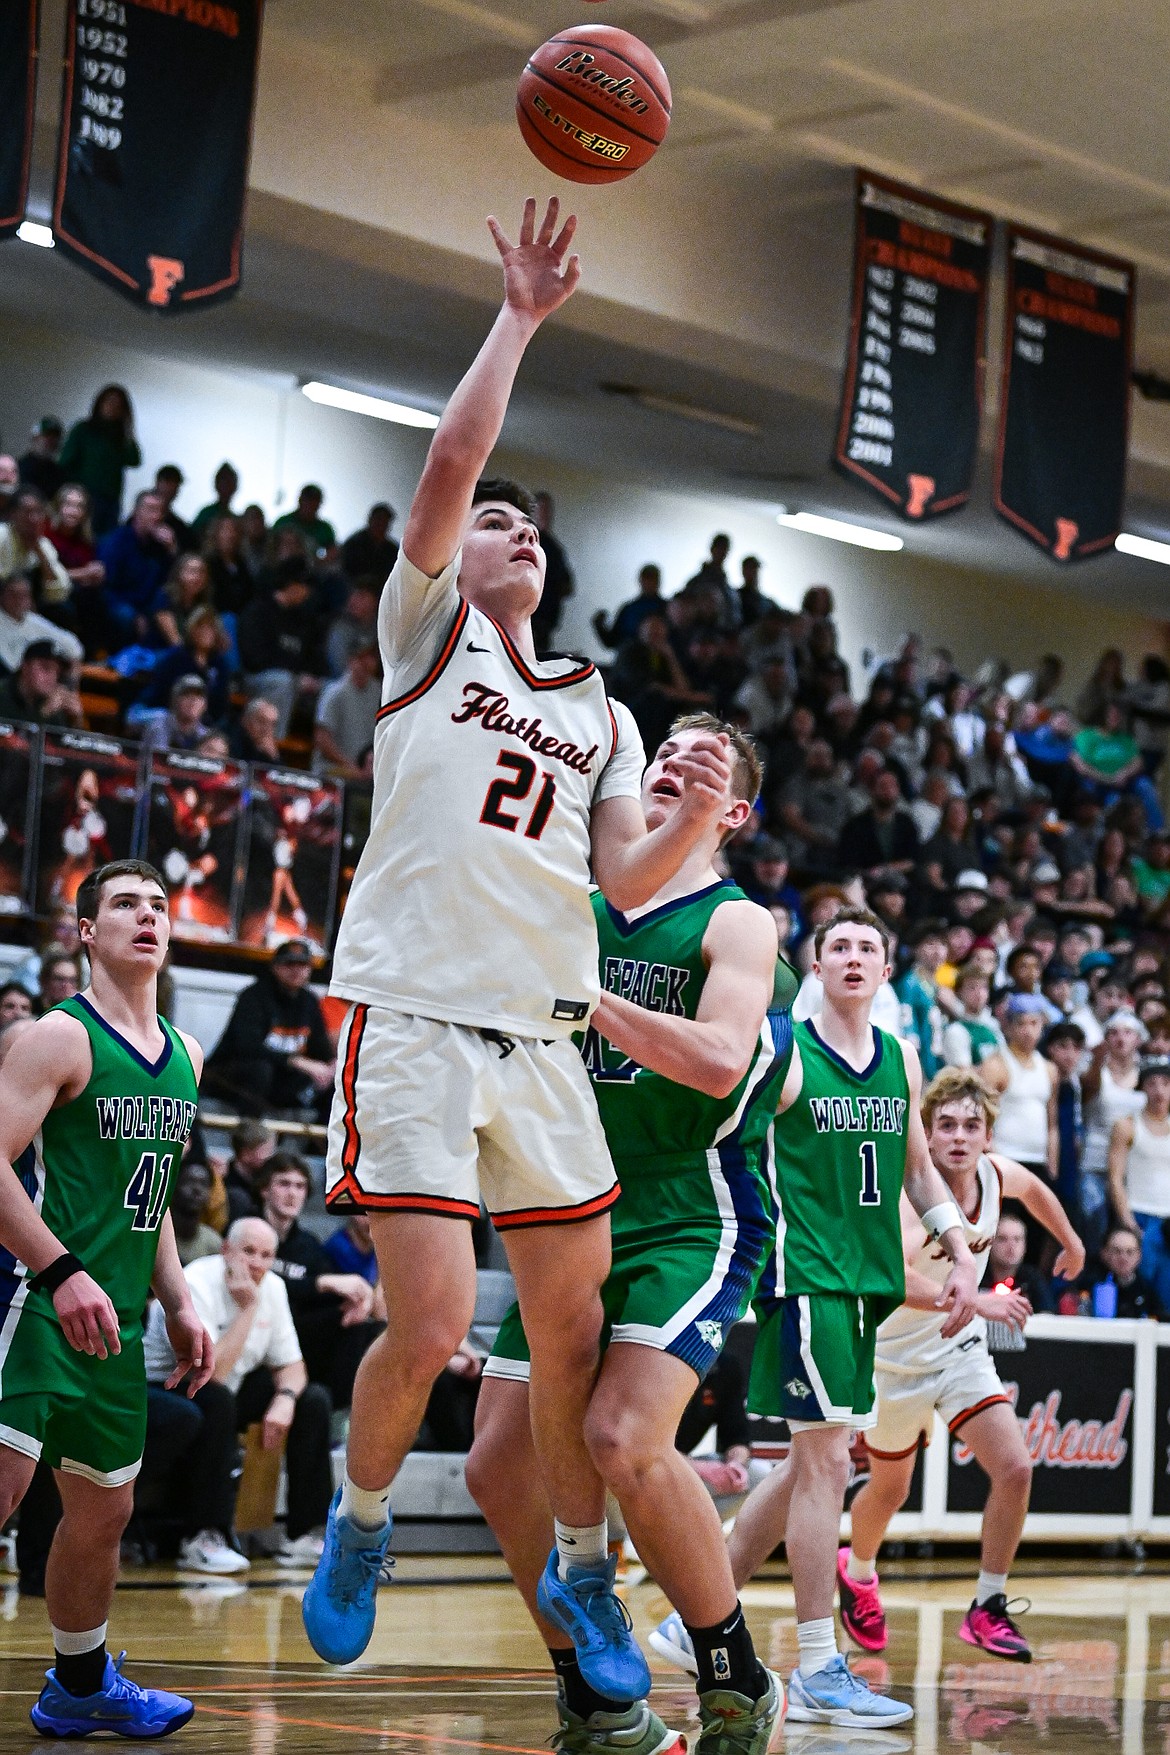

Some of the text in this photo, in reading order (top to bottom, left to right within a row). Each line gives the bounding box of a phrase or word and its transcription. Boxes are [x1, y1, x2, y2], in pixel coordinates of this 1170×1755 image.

[77, 23, 128, 58] 1952
[555, 50, 649, 117] Baden
[533, 93, 596, 149] ELITE
[592, 136, 630, 161] PRO
[147, 254, 185, 306] F
[451, 681, 599, 775] Flathead
[478, 748, 556, 841] 21
[604, 956, 691, 1018] FPACK
[809, 1096, 907, 1136] WOLFPAC
[123, 1151, 174, 1231] 41
[859, 1141, 881, 1206] 1
[952, 1381, 1134, 1469] thead
